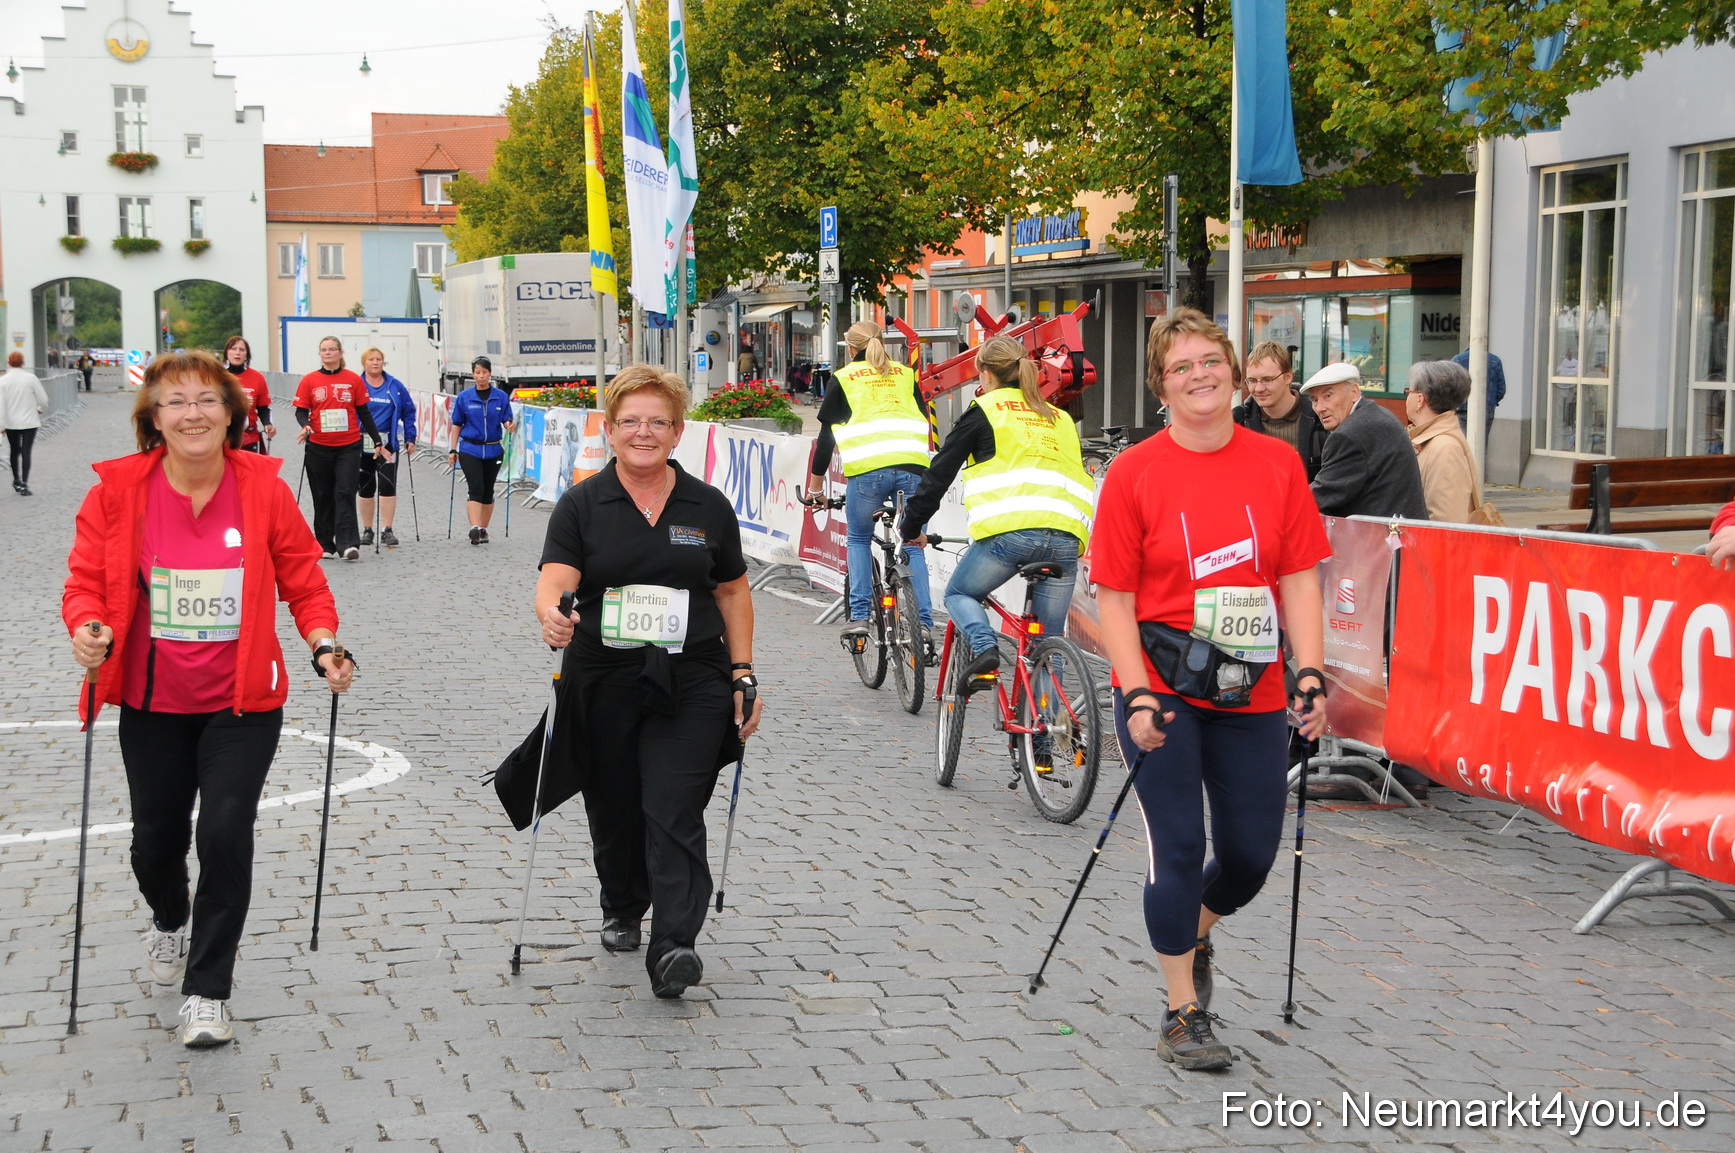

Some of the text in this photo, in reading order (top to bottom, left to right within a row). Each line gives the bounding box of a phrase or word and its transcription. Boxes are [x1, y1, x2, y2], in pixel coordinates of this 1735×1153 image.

[824, 213, 833, 242] P
[699, 355, 704, 364] P
[849, 367, 904, 381] HELER
[996, 401, 1061, 420] HELR
[1211, 550, 1237, 567] DEHN
[175, 575, 200, 591] Inge
[627, 591, 668, 605] Martina
[1222, 592, 1268, 607] Elisabeth
[177, 597, 237, 617] 8053
[627, 612, 680, 633] 8019
[1221, 616, 1272, 636] 8064
[1330, 618, 1363, 632] SEAT
